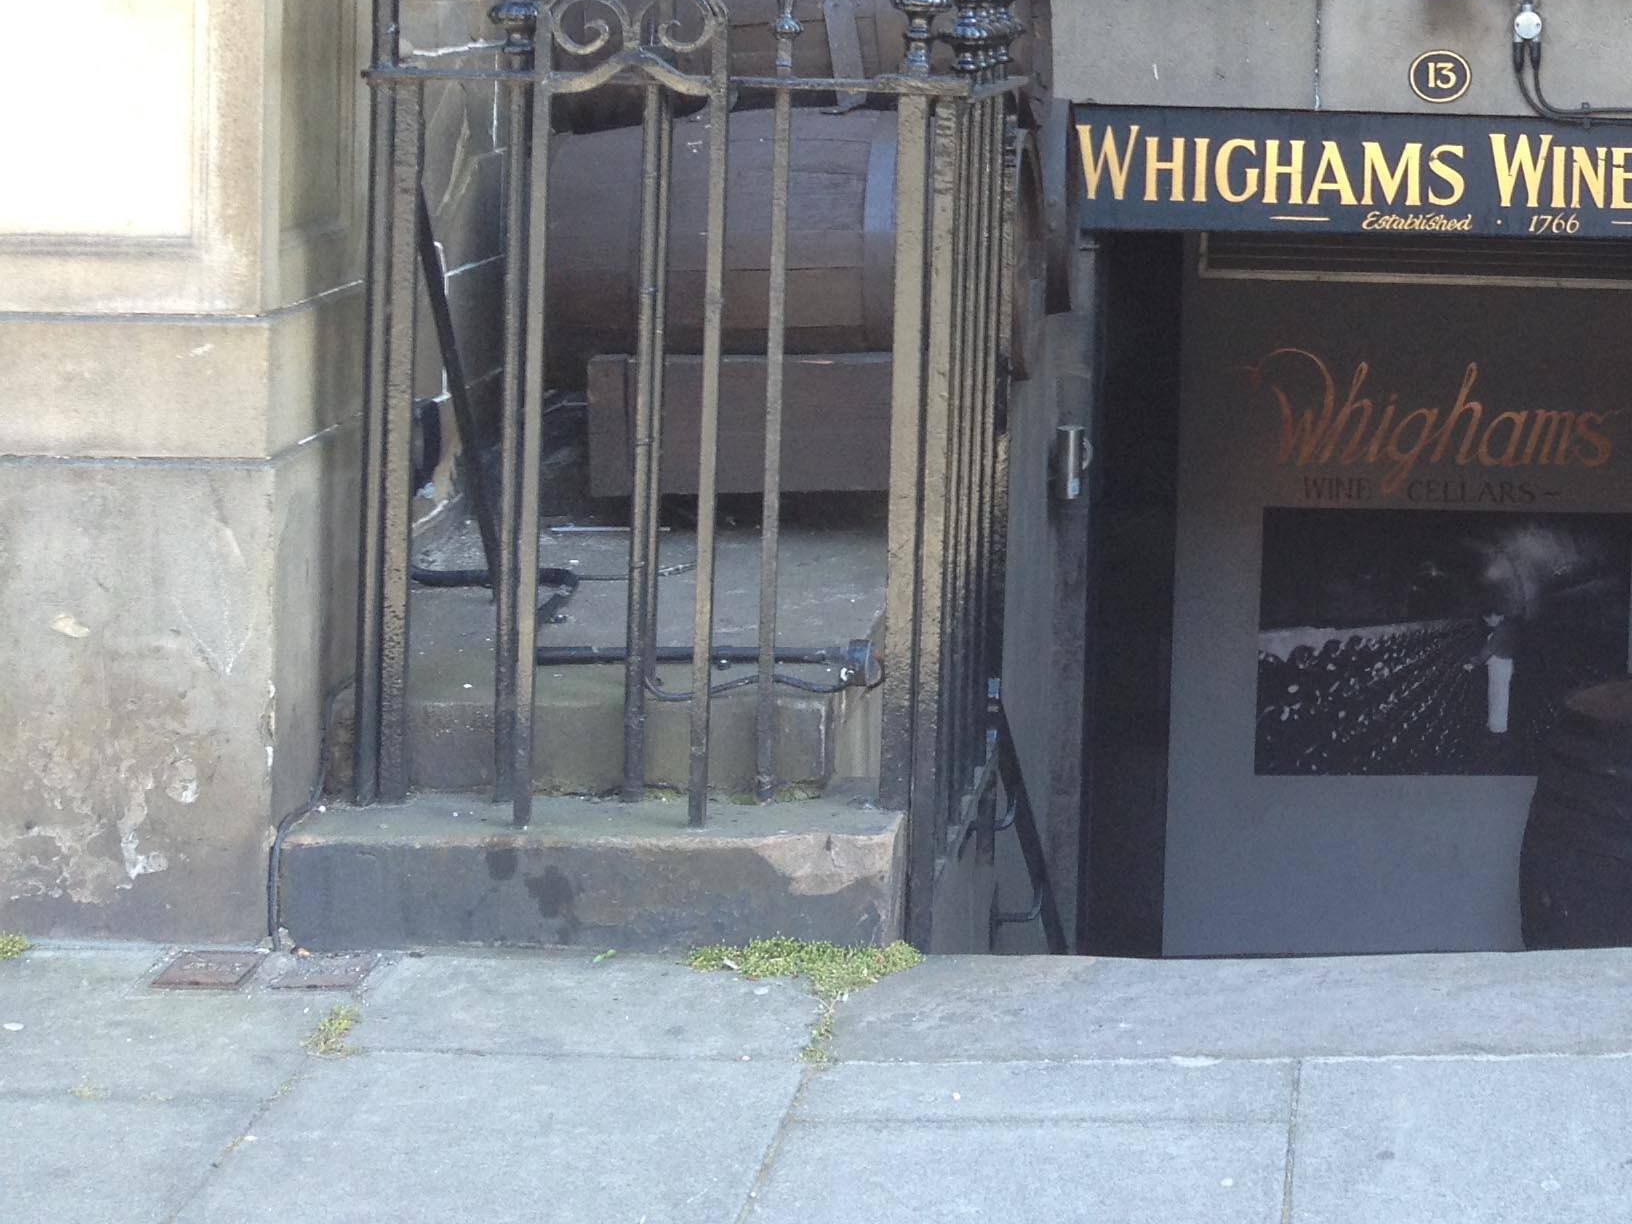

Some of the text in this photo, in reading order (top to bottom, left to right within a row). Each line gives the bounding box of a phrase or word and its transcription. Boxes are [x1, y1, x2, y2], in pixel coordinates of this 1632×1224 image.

[1428, 62, 1457, 89] 13
[1075, 123, 1466, 207] WHIGHAMS
[1361, 211, 1580, 235] Established 1766
[1236, 347, 1622, 496] Whighams
[1303, 477, 1537, 504] WINE CELLARS
